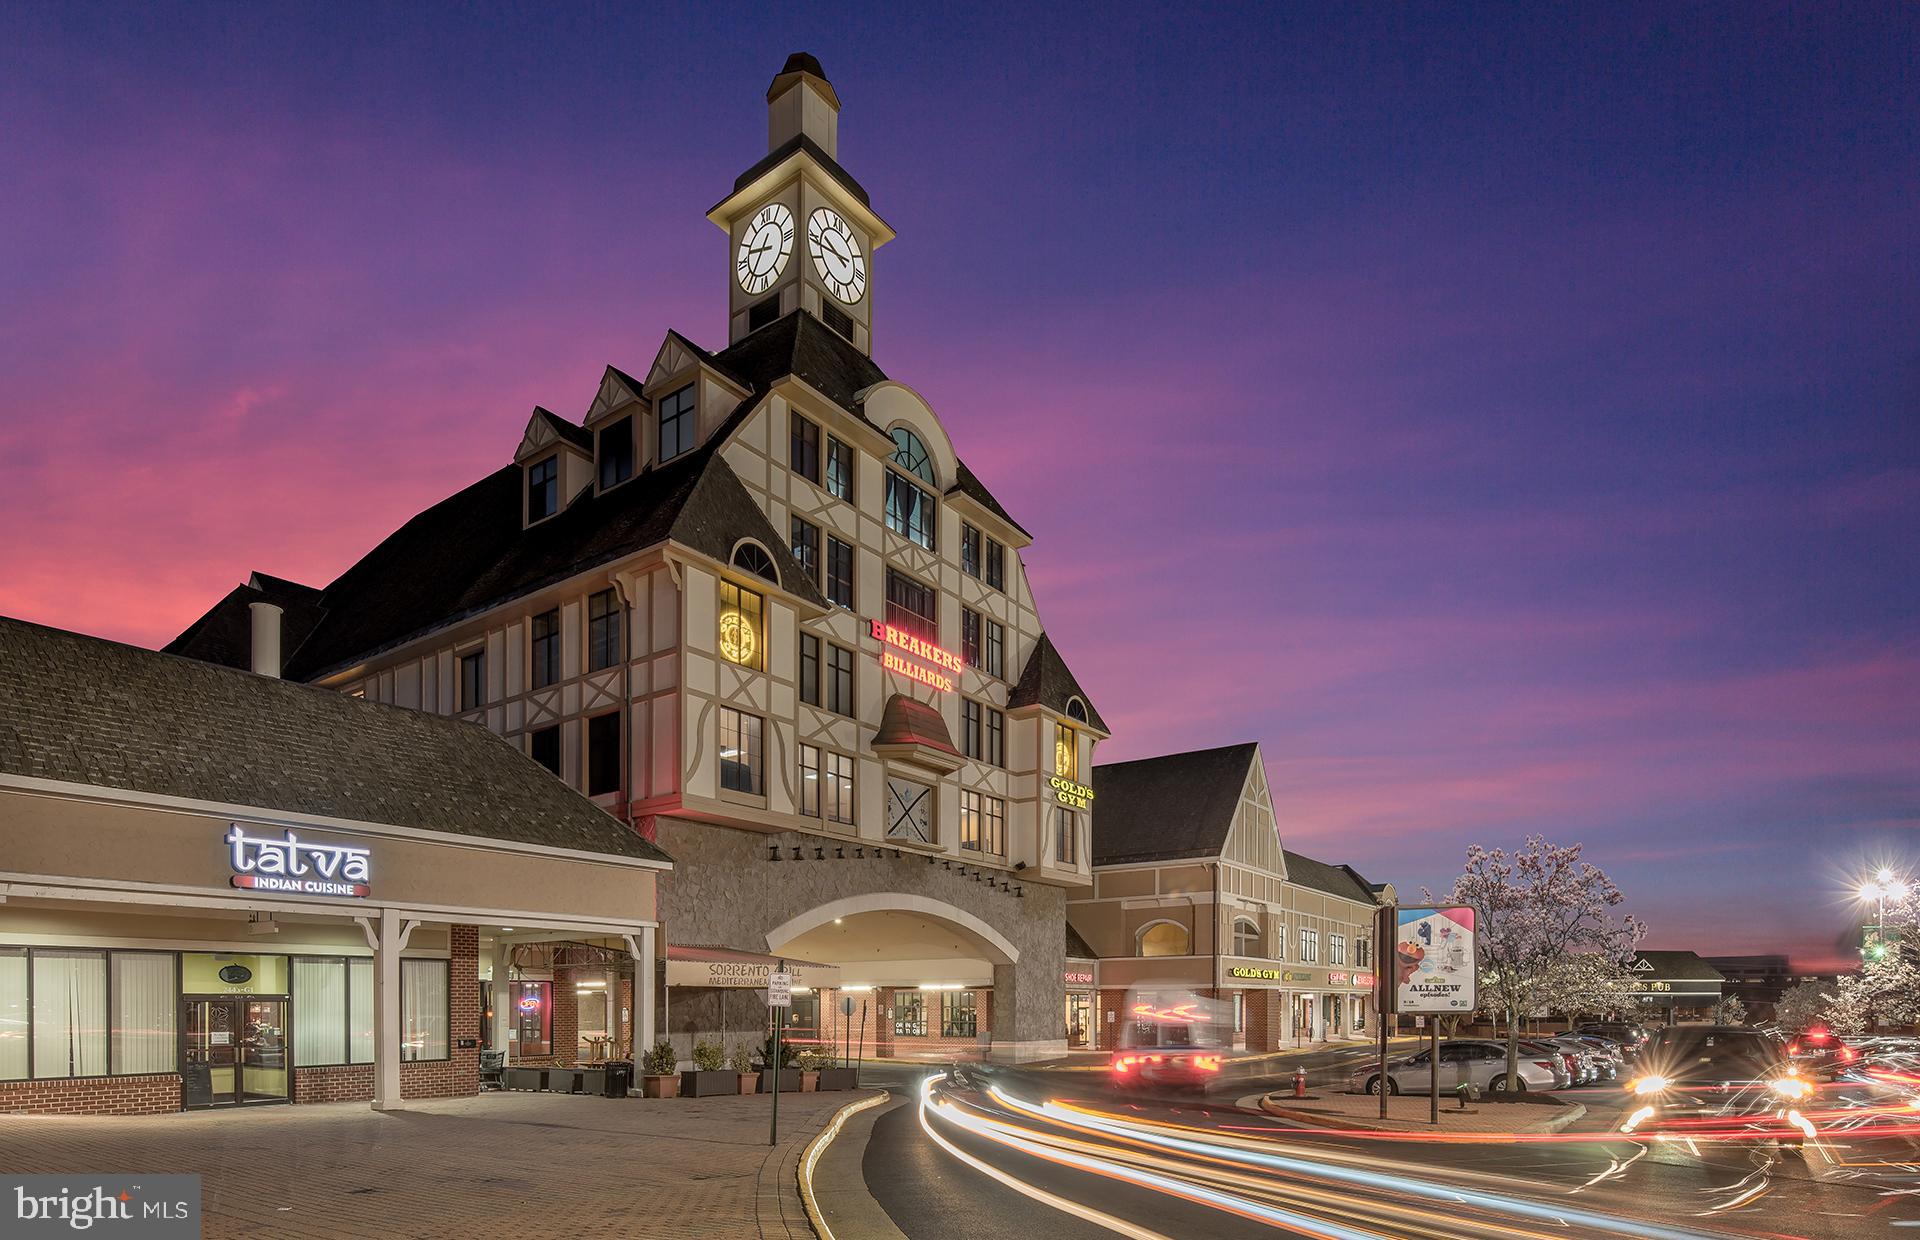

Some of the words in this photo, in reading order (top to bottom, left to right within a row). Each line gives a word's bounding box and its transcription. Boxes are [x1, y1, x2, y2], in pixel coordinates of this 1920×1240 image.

[869, 619, 962, 674] BREAKERS
[883, 652, 952, 692] BILLIARDS
[1050, 777, 1094, 800] GOLD'S
[1057, 791, 1087, 809] GYM
[254, 876, 302, 891] INDIAN
[305, 880, 354, 895] CUISINE
[708, 963, 770, 977] SORRENTO
[1233, 967, 1262, 979] GOLD'S
[1262, 968, 1280, 980] GYM
[708, 976, 769, 986] MEDITERRANEA
[1651, 981, 1671, 992] PUB
[520, 1000, 538, 1008] OPEN
